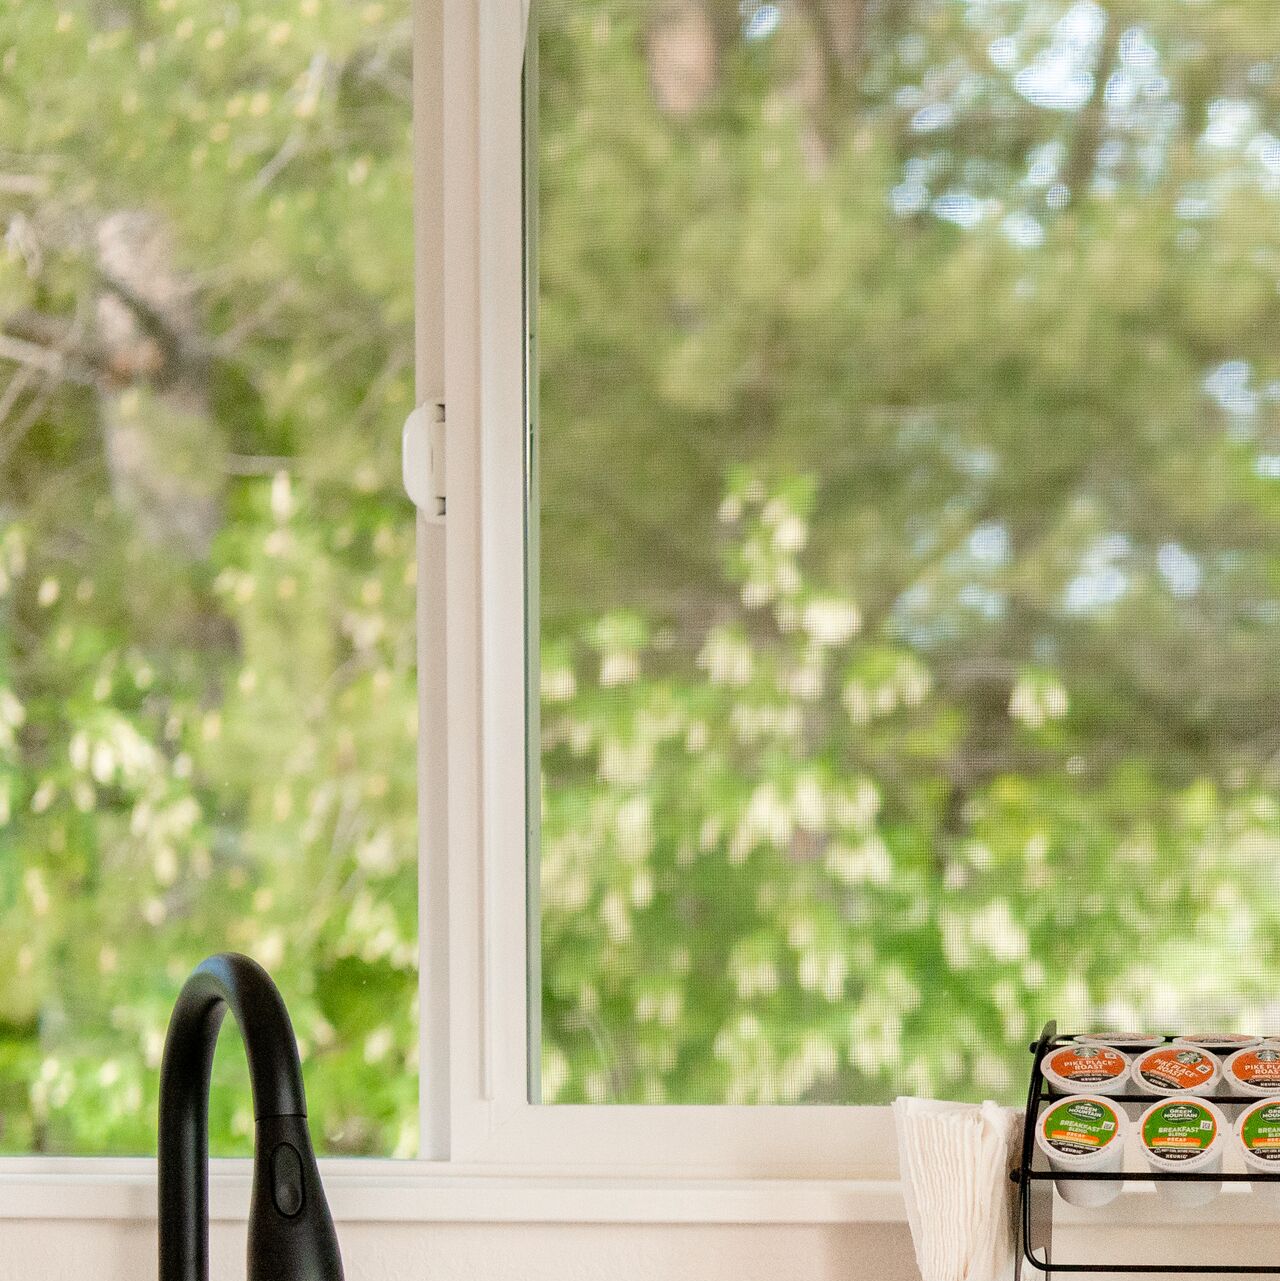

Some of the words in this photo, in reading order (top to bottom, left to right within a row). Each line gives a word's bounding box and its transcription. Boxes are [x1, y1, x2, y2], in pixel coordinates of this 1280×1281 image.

[1154, 1058, 1171, 1068] PIKE
[1172, 1064, 1196, 1078] PLACE
[1156, 1066, 1183, 1077] ROAST
[1069, 1109, 1101, 1118] MOUNTAIN
[1060, 1120, 1100, 1132] BREAKFAST
[1069, 1126, 1088, 1134] BLEND
